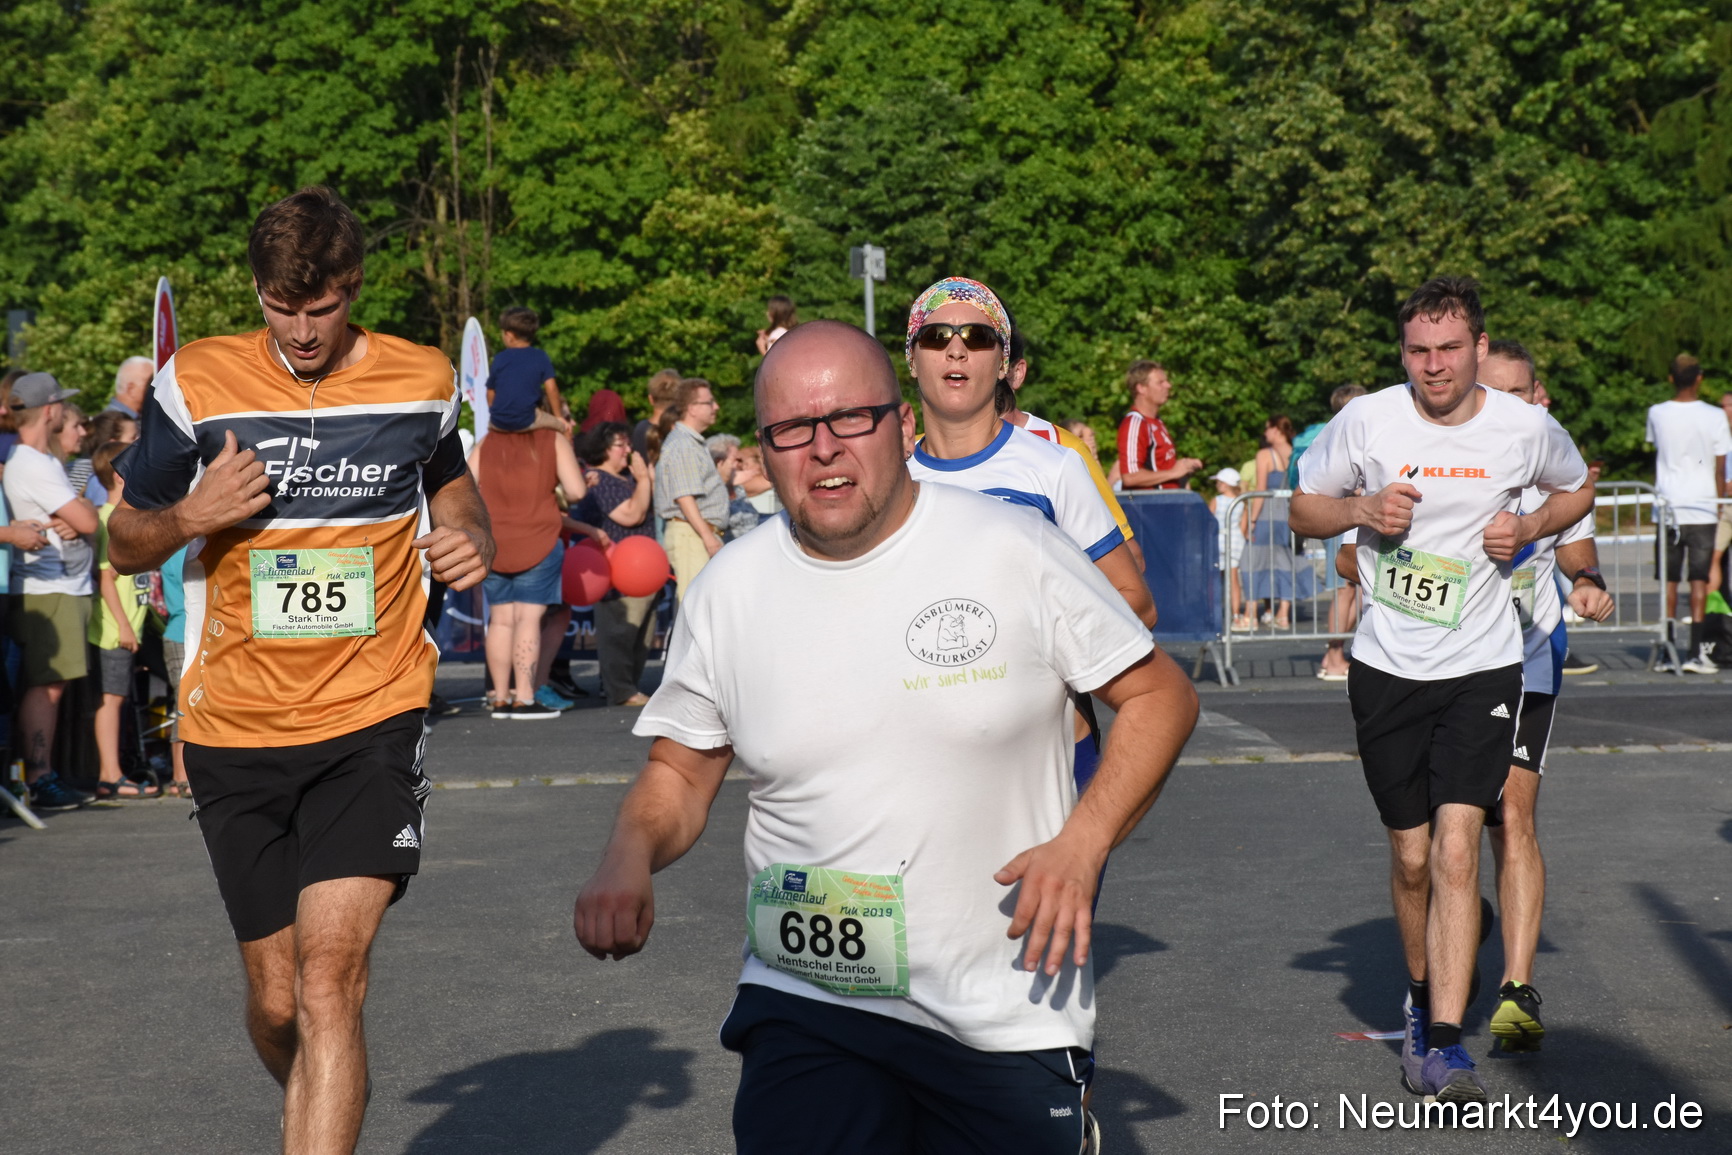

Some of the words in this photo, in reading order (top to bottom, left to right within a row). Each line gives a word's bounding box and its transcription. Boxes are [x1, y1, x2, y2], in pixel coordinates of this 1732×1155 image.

[265, 458, 397, 483] Fischer
[1423, 467, 1491, 478] KLEBL
[275, 486, 387, 497] AUTOMOBILE
[268, 566, 316, 576] firmenlauf
[344, 571, 366, 580] 2019
[1386, 567, 1449, 606] 1151
[276, 582, 346, 613] 785
[1412, 599, 1436, 612] Tobias
[288, 615, 312, 623] Stark
[315, 614, 338, 623] Timo
[915, 601, 984, 629] EISBLÜMERL
[918, 638, 988, 663] NATURKOST
[902, 674, 930, 690] Wir
[938, 666, 967, 687] sind
[771, 886, 828, 905] firmenlauf
[862, 907, 893, 917] 2019
[779, 910, 866, 961] 688
[777, 954, 832, 972] Hentschel
[836, 962, 876, 974] Enrico
[814, 973, 852, 983] Naturkost
[854, 976, 881, 984] GmbH
[1050, 1106, 1073, 1117] Reebok
